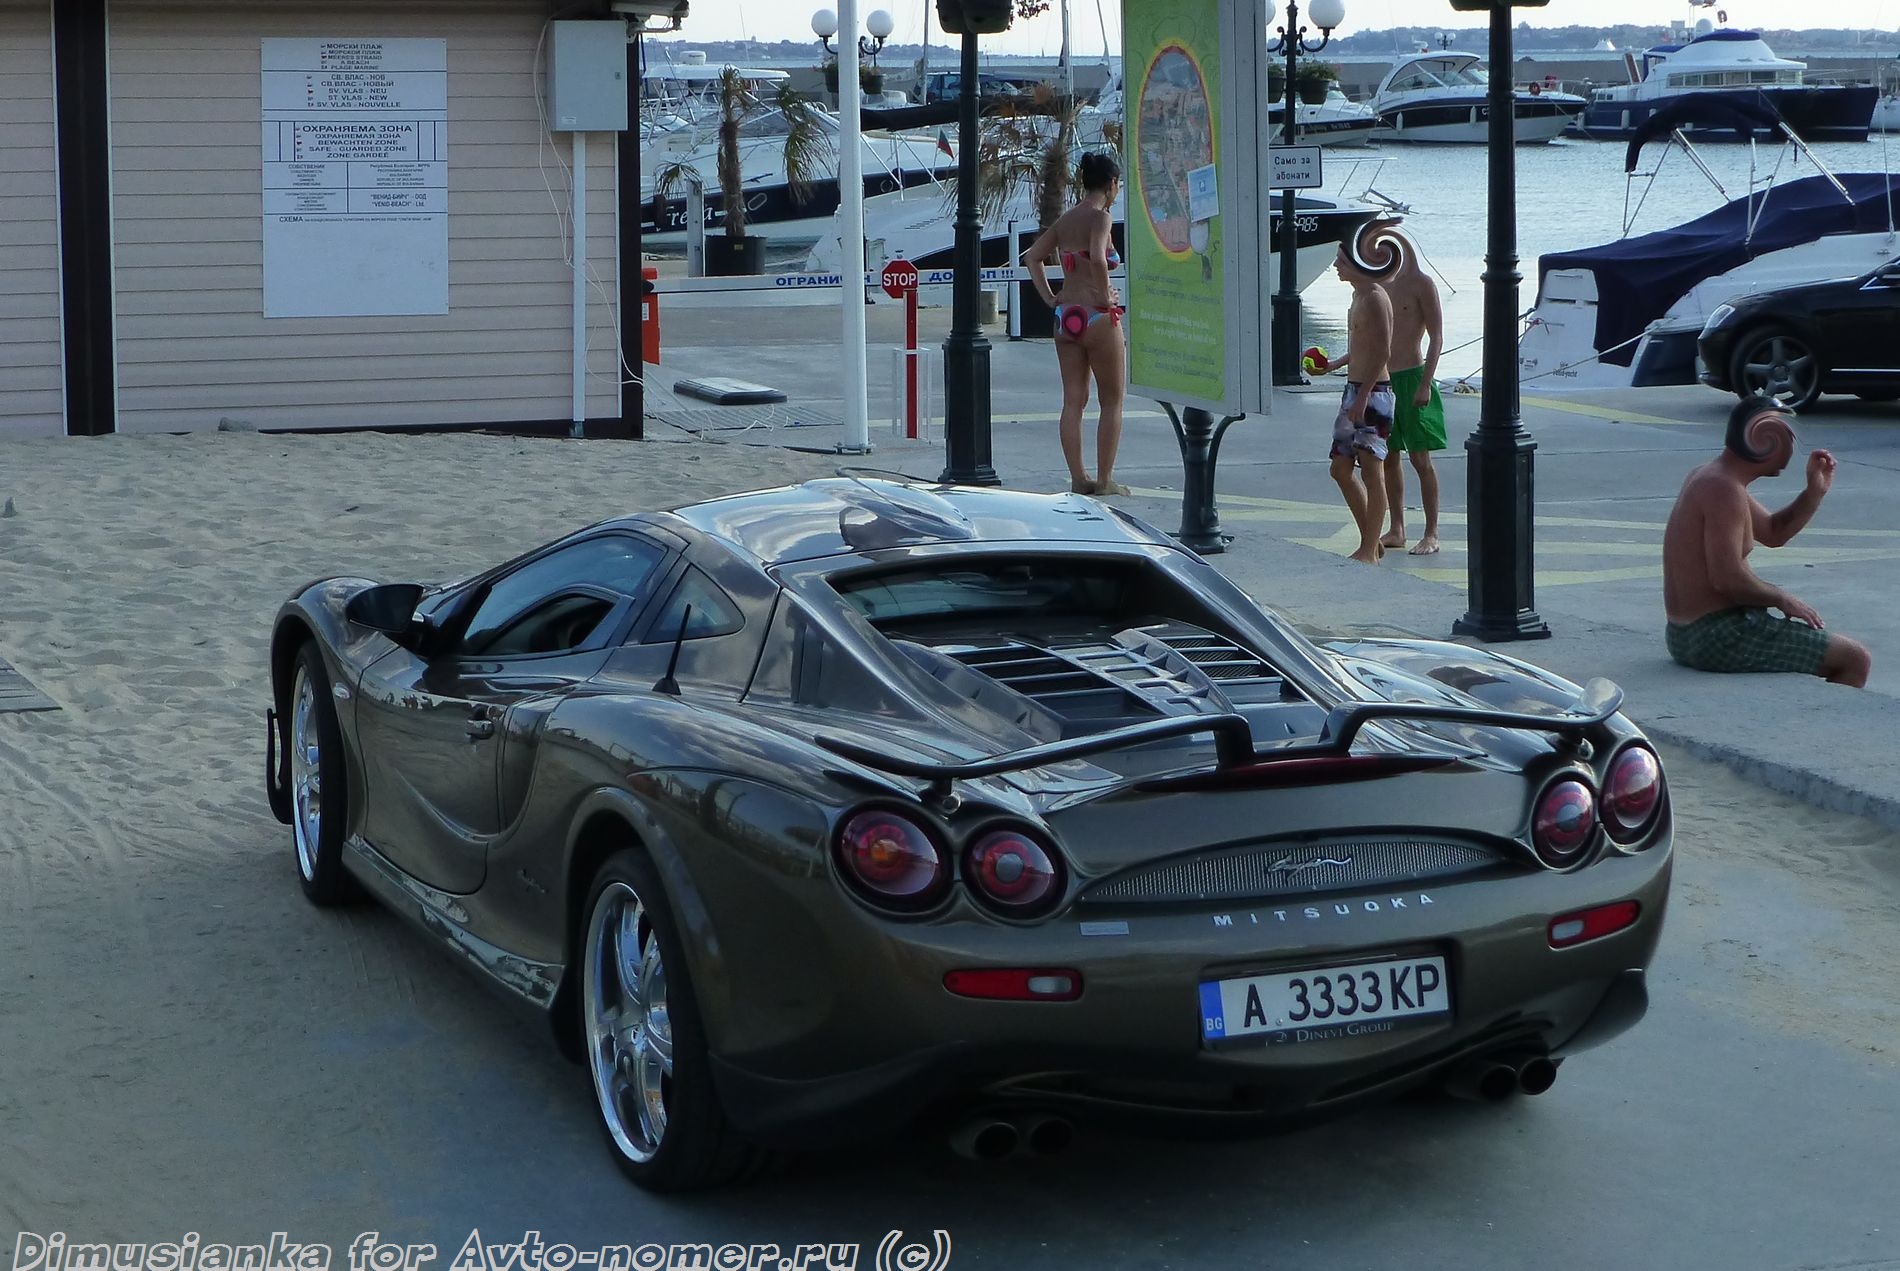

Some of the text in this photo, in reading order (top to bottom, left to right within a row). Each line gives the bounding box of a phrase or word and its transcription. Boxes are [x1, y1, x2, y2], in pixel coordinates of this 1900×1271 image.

[1274, 156, 1297, 166] Само
[1276, 171, 1310, 180] абонати
[883, 273, 917, 286] STOP
[1212, 893, 1436, 928] MITSUOKA
[1205, 1017, 1223, 1032] BG
